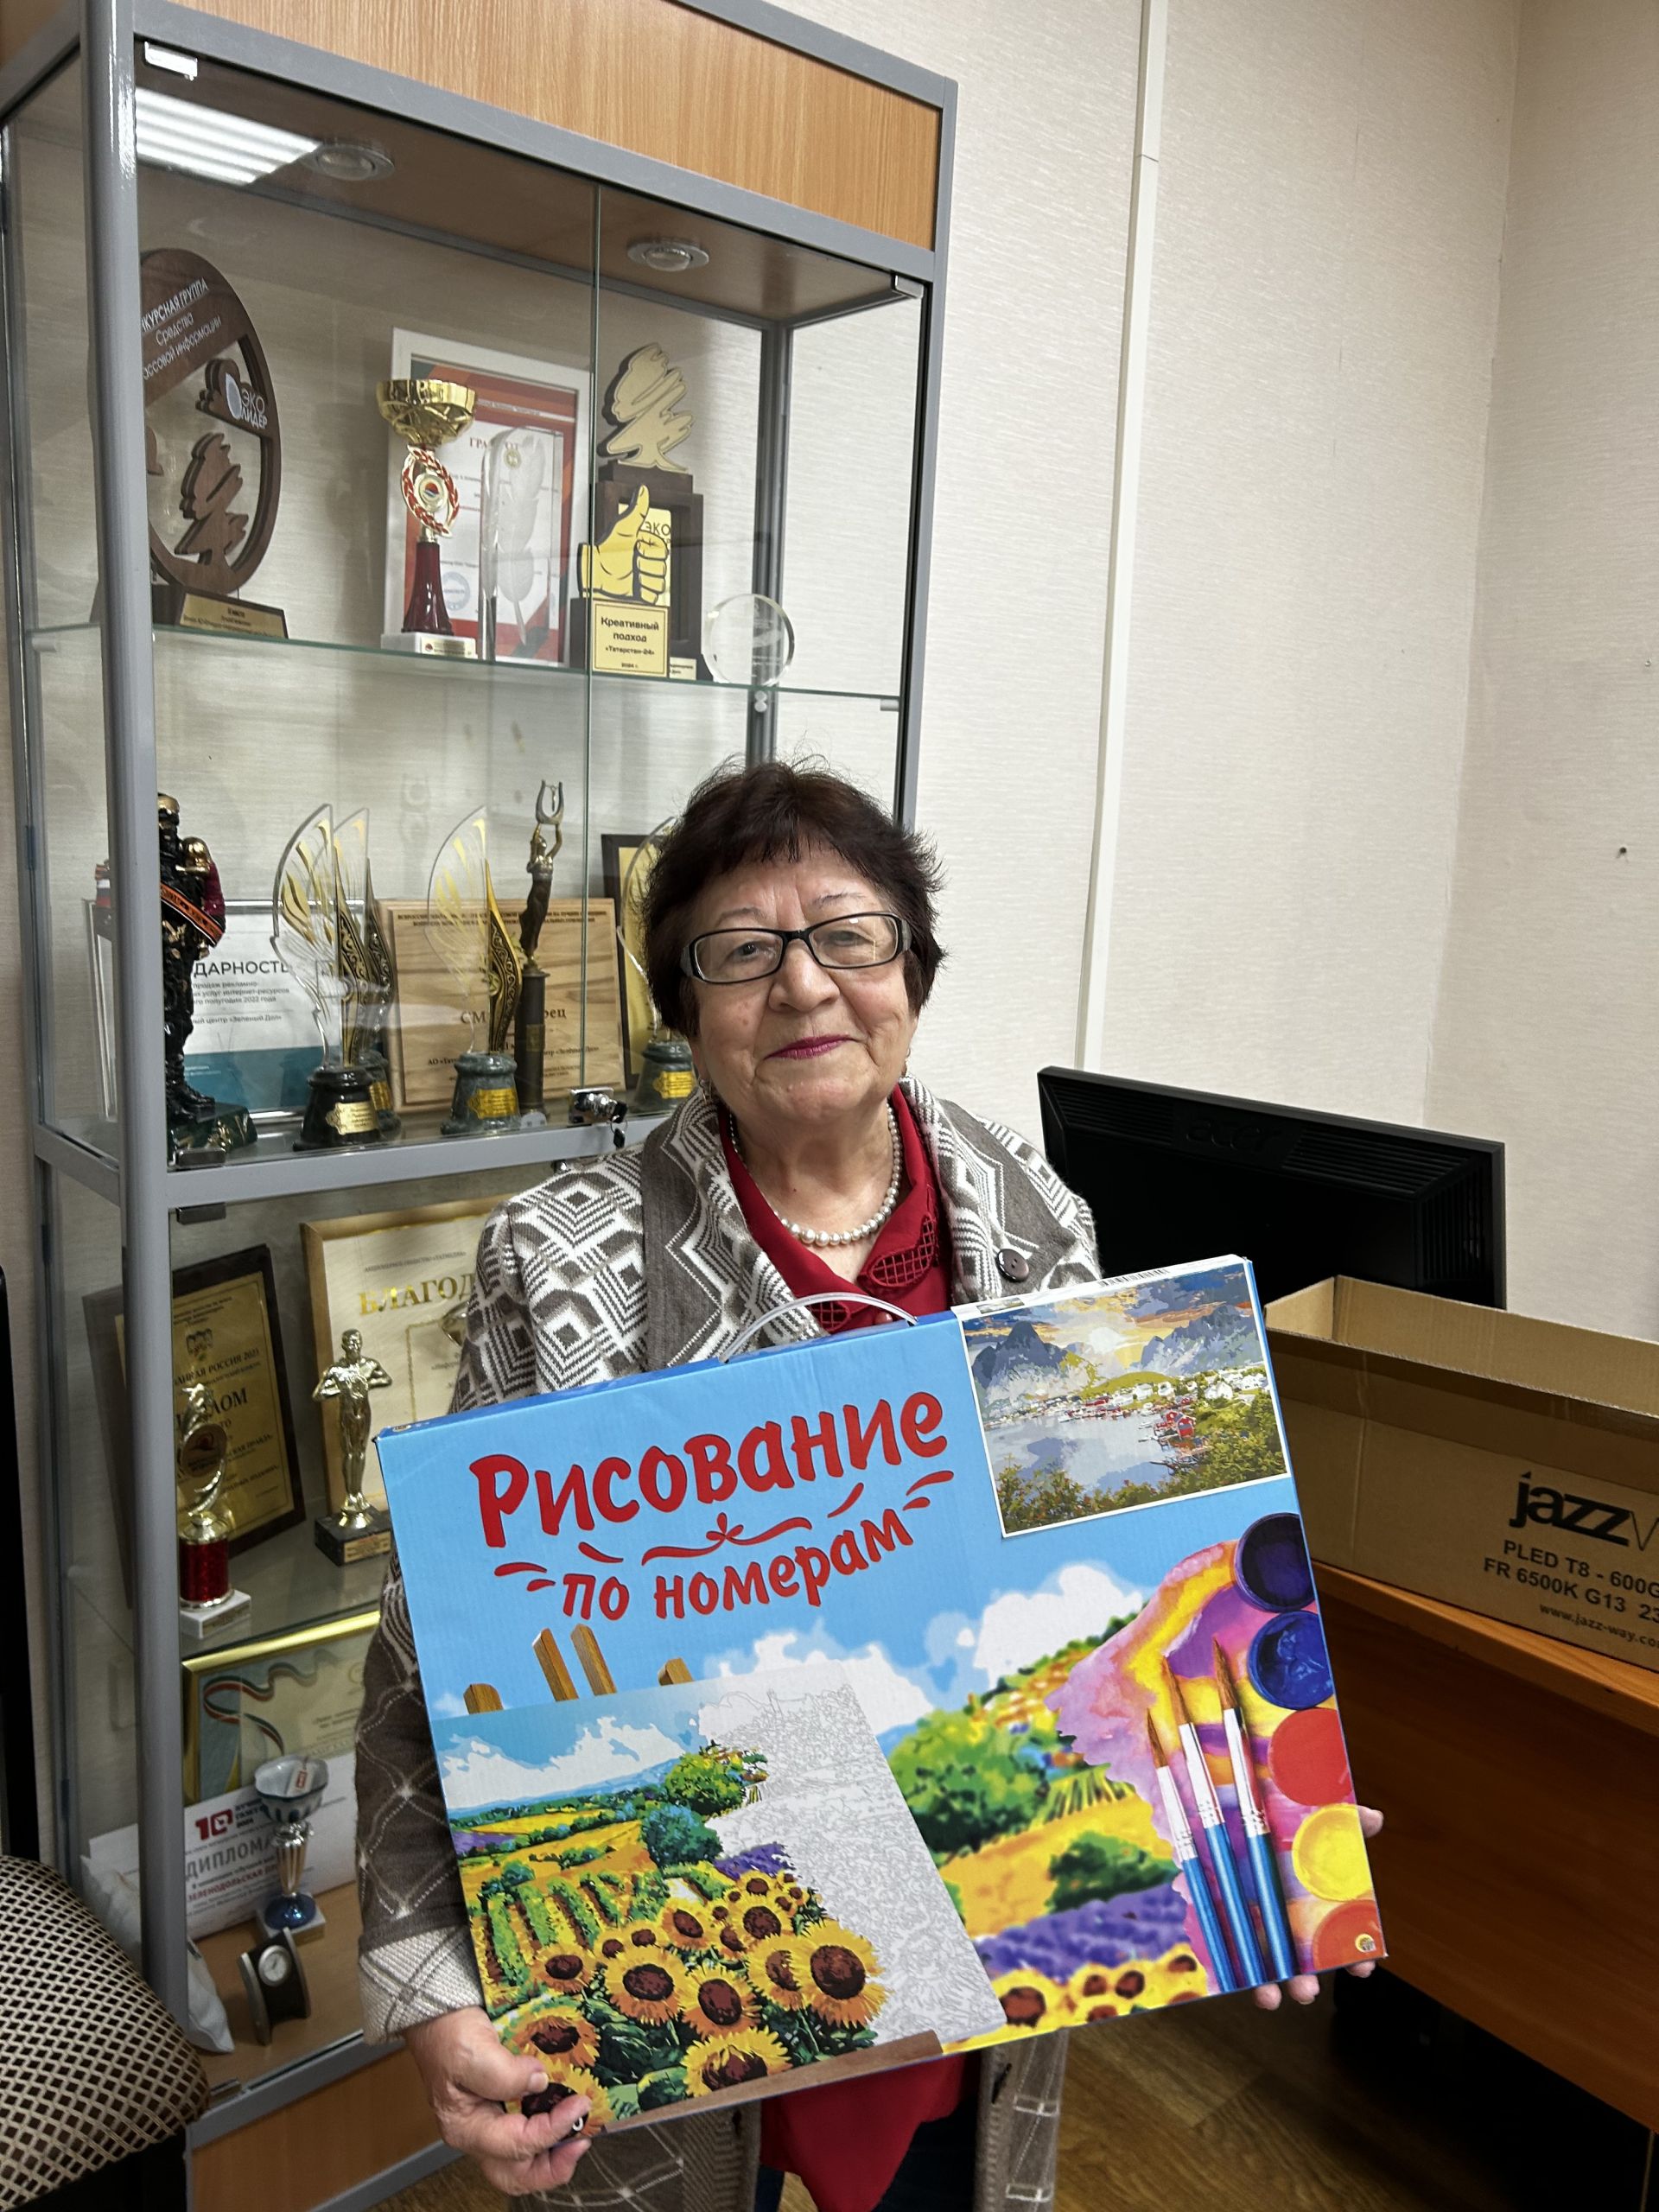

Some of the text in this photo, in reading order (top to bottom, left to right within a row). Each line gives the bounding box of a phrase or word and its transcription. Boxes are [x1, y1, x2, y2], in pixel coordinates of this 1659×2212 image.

[179, 276, 209, 309] ГРУППА
[156, 312, 194, 346] Средства
[143, 346, 177, 380] ассовой
[241, 387, 265, 416] ЭКО
[241, 406, 268, 429] ЛИДЕР
[601, 617, 659, 631] Креативный
[613, 632, 647, 643] подход
[469, 1391, 948, 1548] Рисование
[562, 1508, 915, 1621] по номерам
[1503, 1540, 1559, 1569] PLED
[1565, 1557, 1591, 1579] T8
[1484, 1557, 1511, 1580] FR
[1516, 1567, 1580, 1599] 6500K
[1585, 1588, 1626, 1613] G13
